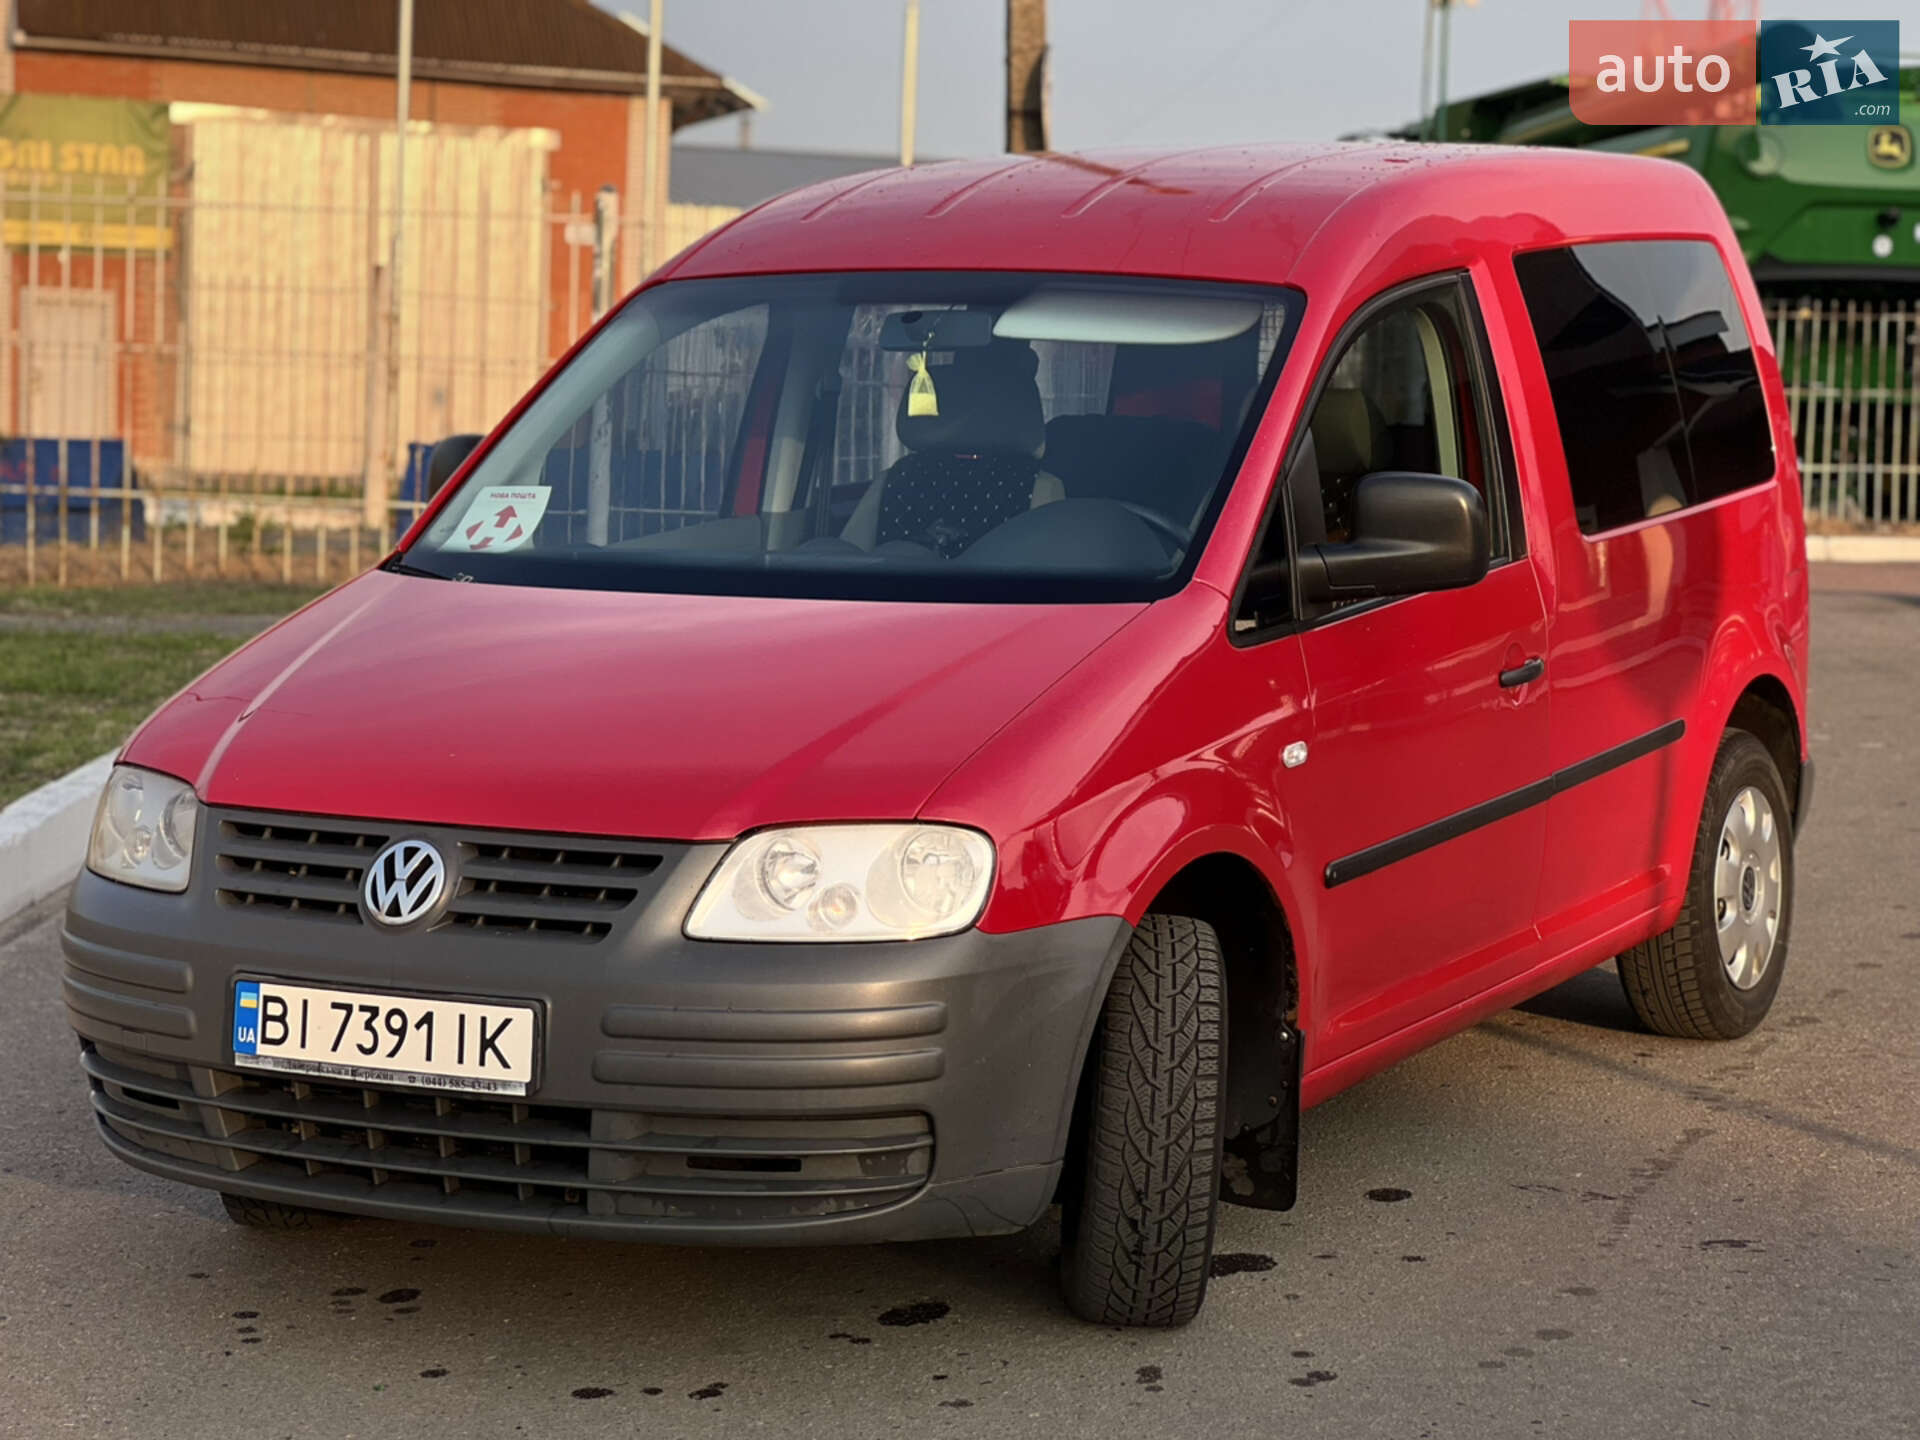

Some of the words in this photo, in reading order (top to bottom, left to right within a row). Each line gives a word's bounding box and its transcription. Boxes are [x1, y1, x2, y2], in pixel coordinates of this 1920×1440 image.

[237, 1026, 256, 1043] UA
[260, 995, 308, 1049] BI
[330, 1001, 434, 1062] 7391
[457, 1013, 513, 1070] IK
[421, 1074, 446, 1087] (044)
